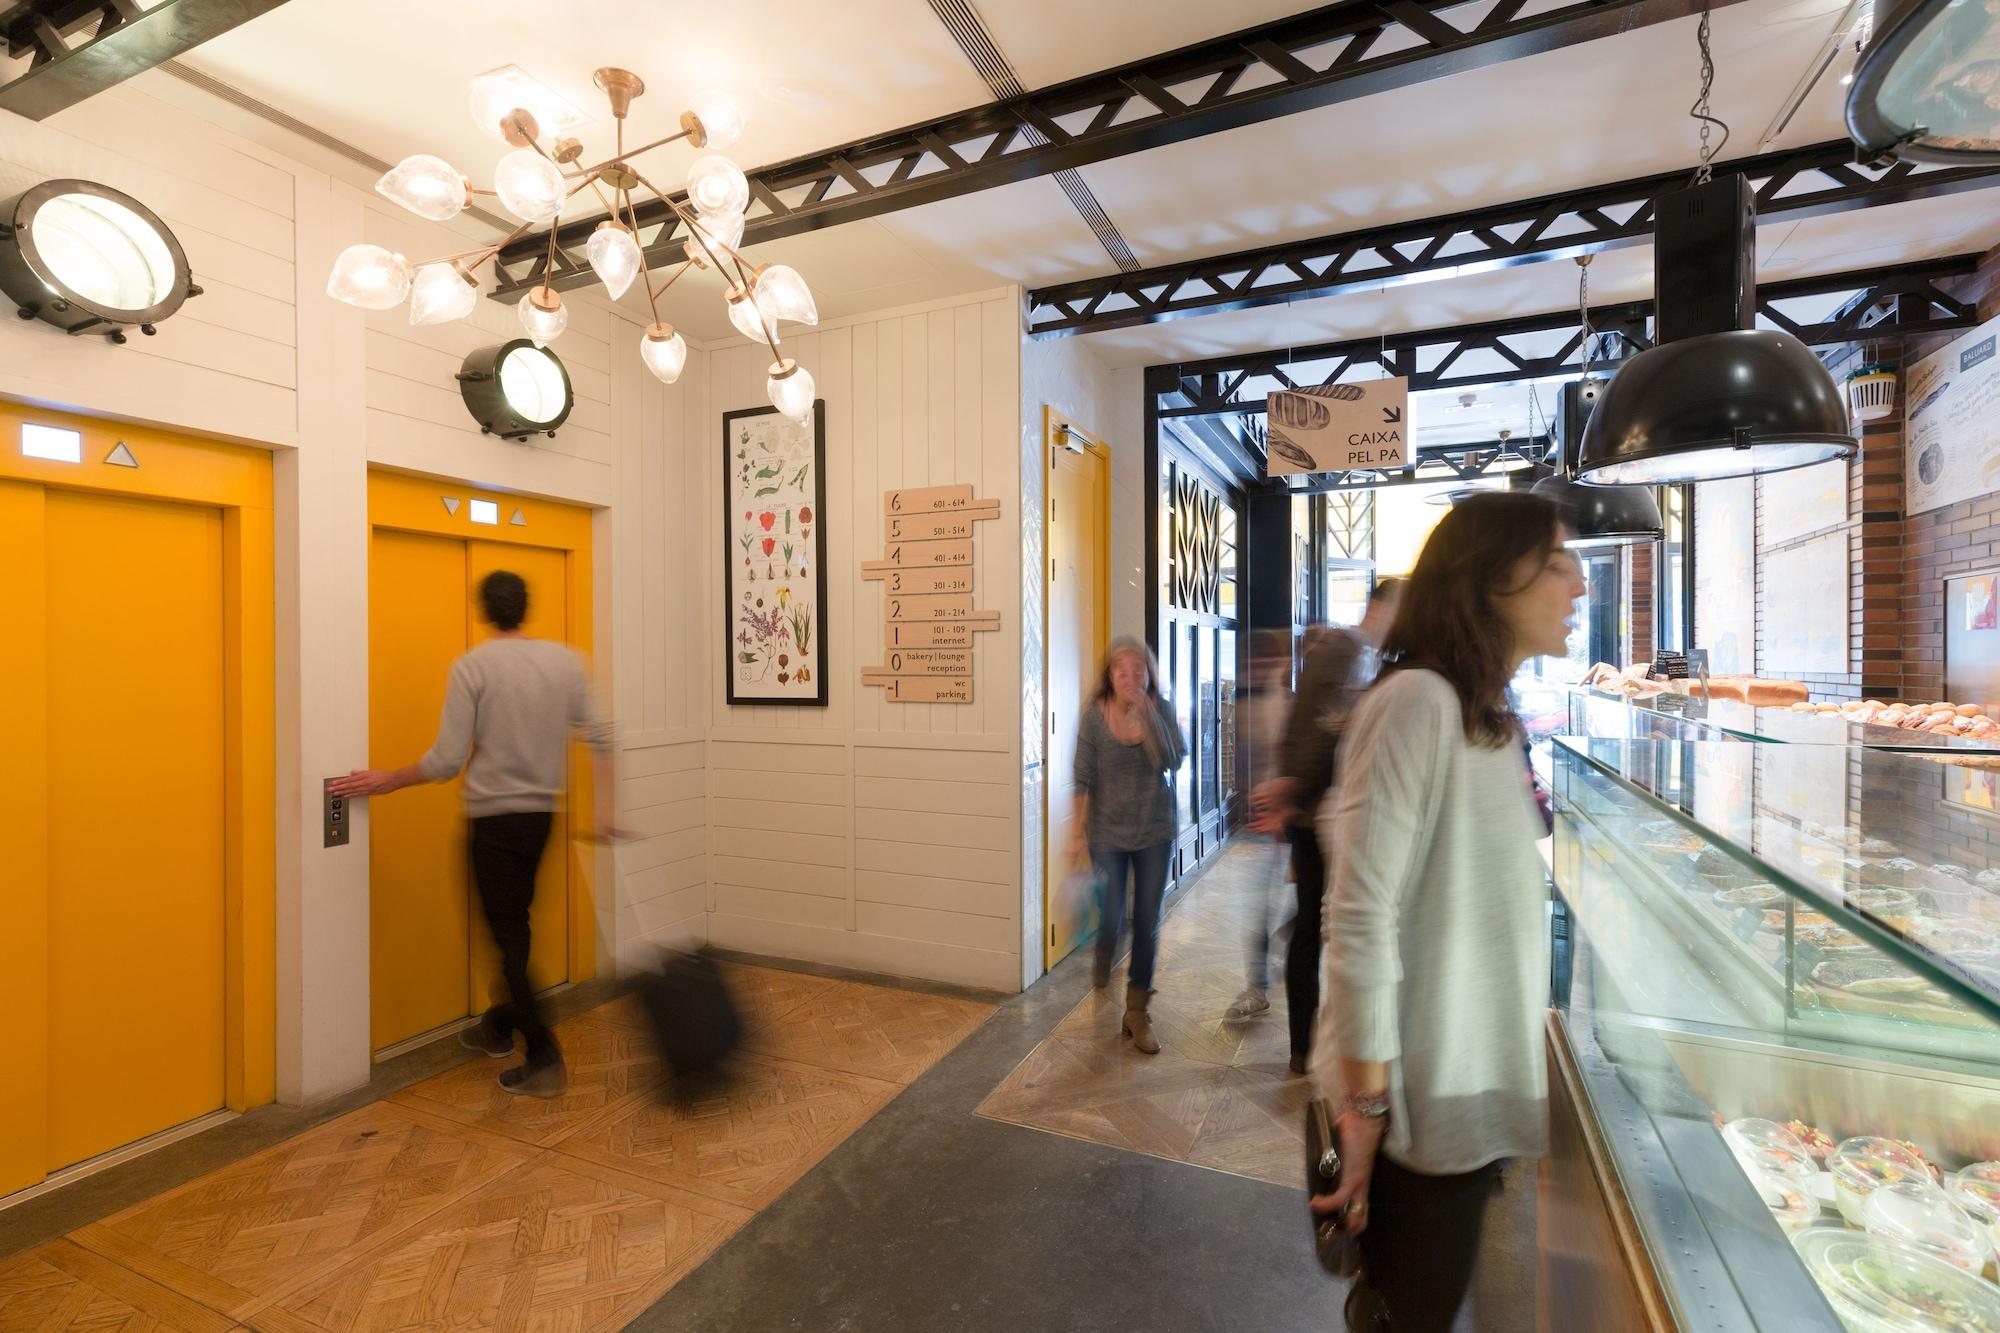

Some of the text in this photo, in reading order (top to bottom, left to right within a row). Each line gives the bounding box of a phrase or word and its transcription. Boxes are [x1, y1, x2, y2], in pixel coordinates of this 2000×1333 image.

[1348, 430, 1401, 446] CAIXA
[1348, 448, 1400, 464] PEL PA
[891, 493, 901, 511] 6
[933, 500, 945, 509] 601
[952, 498, 965, 507] 614
[891, 519, 901, 537] 5
[933, 527, 945, 536] 501
[952, 526, 965, 535] 514
[891, 546, 901, 565] 4
[934, 554, 945, 563] 401
[952, 553, 965, 562] 414
[891, 573, 901, 591] 3
[933, 581, 945, 590] 301
[952, 581, 965, 589] 314
[891, 600, 902, 618] 2
[933, 609, 945, 617] 201
[952, 608, 965, 617] 214
[933, 626, 944, 634] 101
[953, 625, 966, 634] 109
[932, 637, 966, 645] internet
[891, 653, 901, 671] 0
[927, 665, 966, 674] reception
[887, 680, 899, 698] -1
[936, 690, 967, 701] parking
